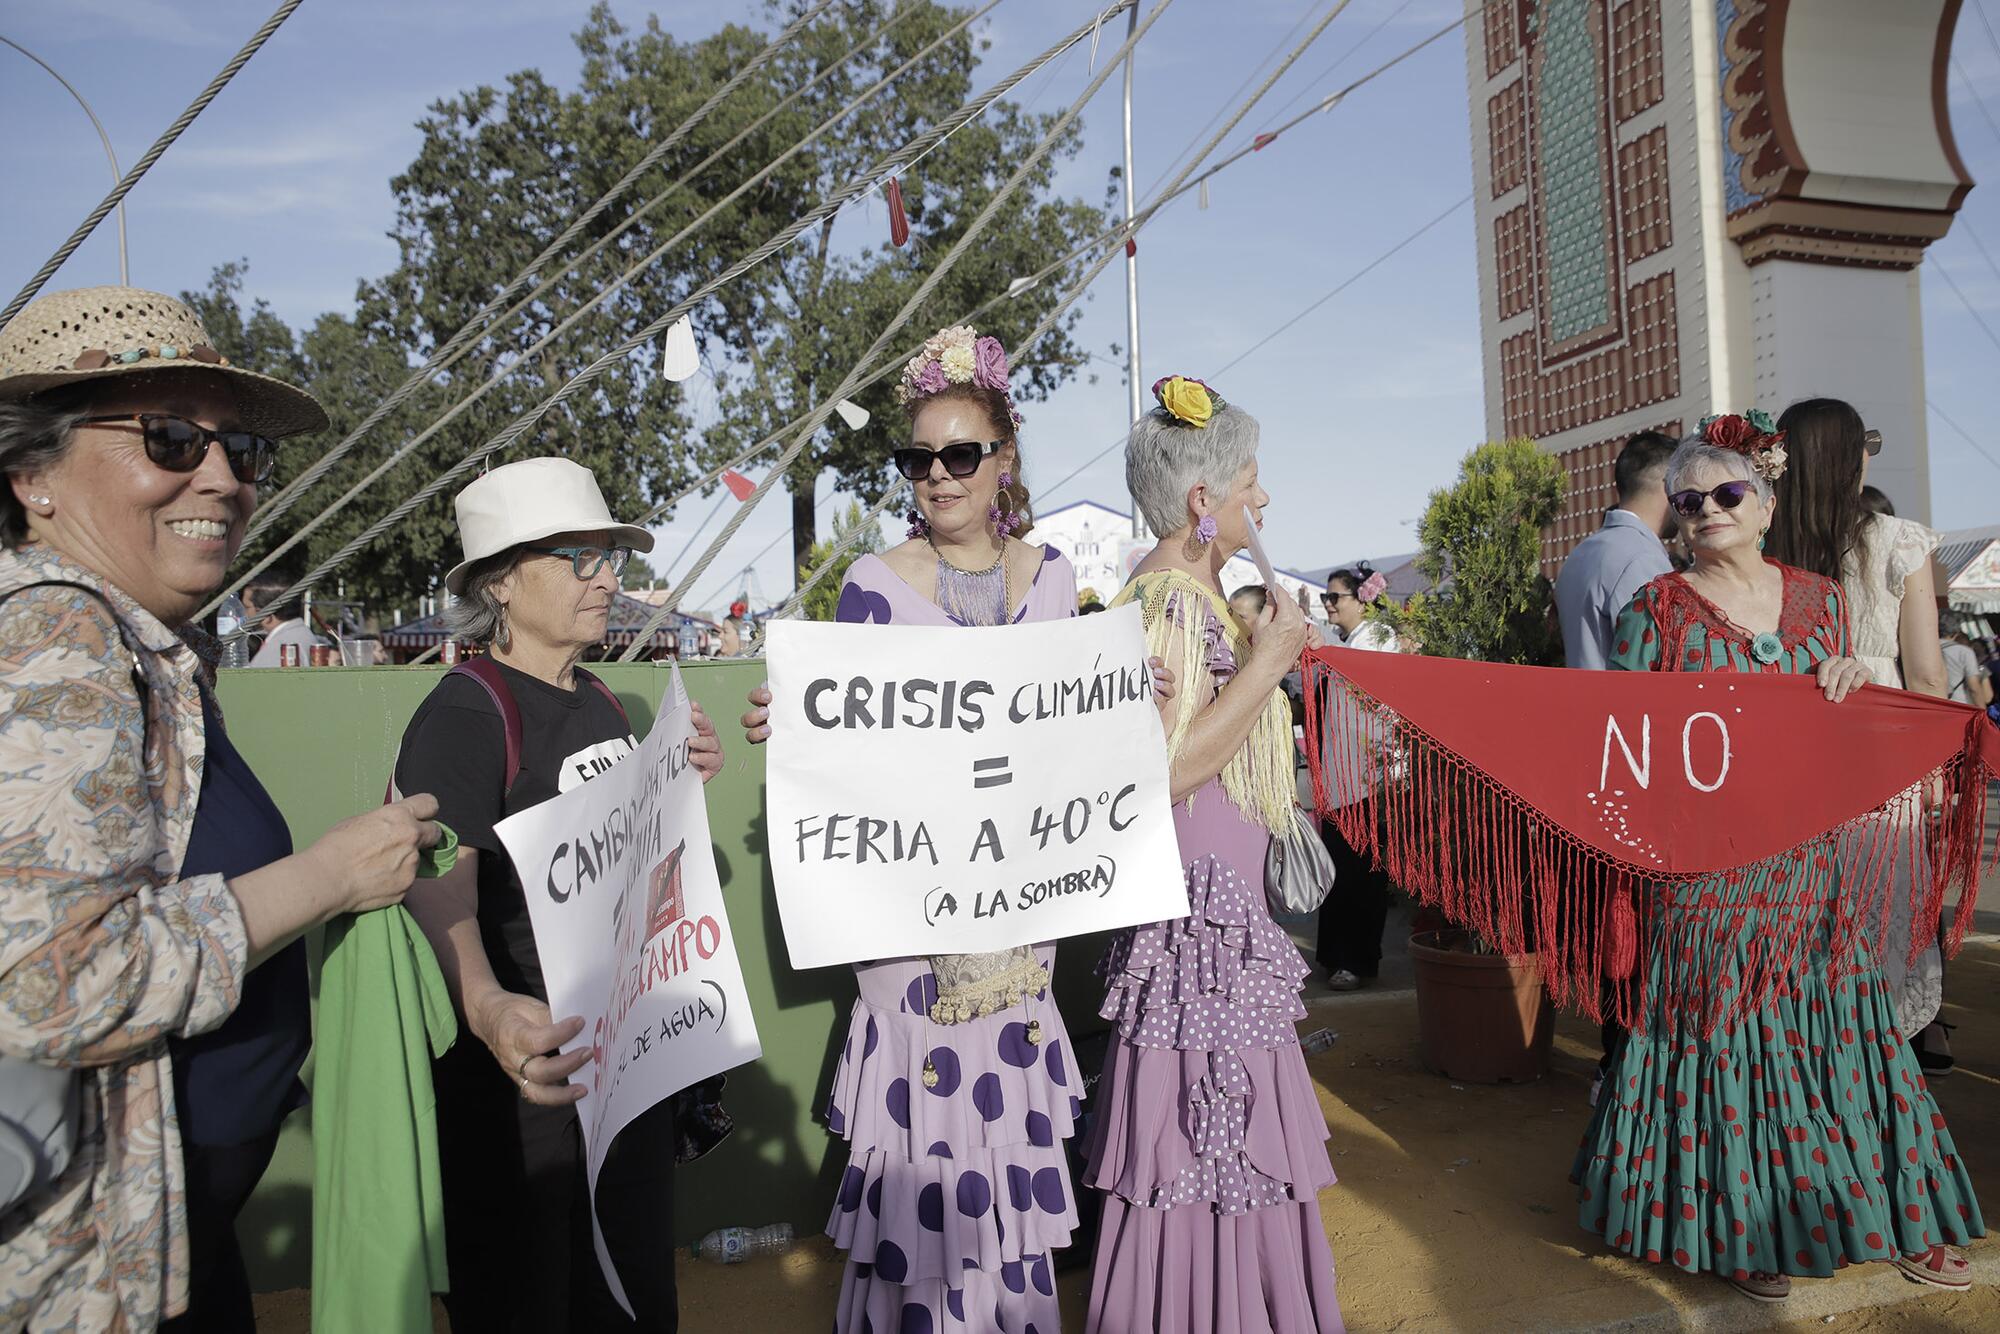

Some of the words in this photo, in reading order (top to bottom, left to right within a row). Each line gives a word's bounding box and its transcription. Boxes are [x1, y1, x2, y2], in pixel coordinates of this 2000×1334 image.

[802, 676, 995, 733] CRISIS
[1007, 653, 1153, 724] CLIMÁTICA
[1599, 711, 1731, 792] NO
[547, 800, 637, 904] CAMBIO
[794, 813, 938, 866] FERIA
[969, 818, 1005, 863] A
[973, 888, 1009, 918] LA
[1017, 855, 1116, 911] SOMBRA)
[632, 1025, 652, 1061] DE
